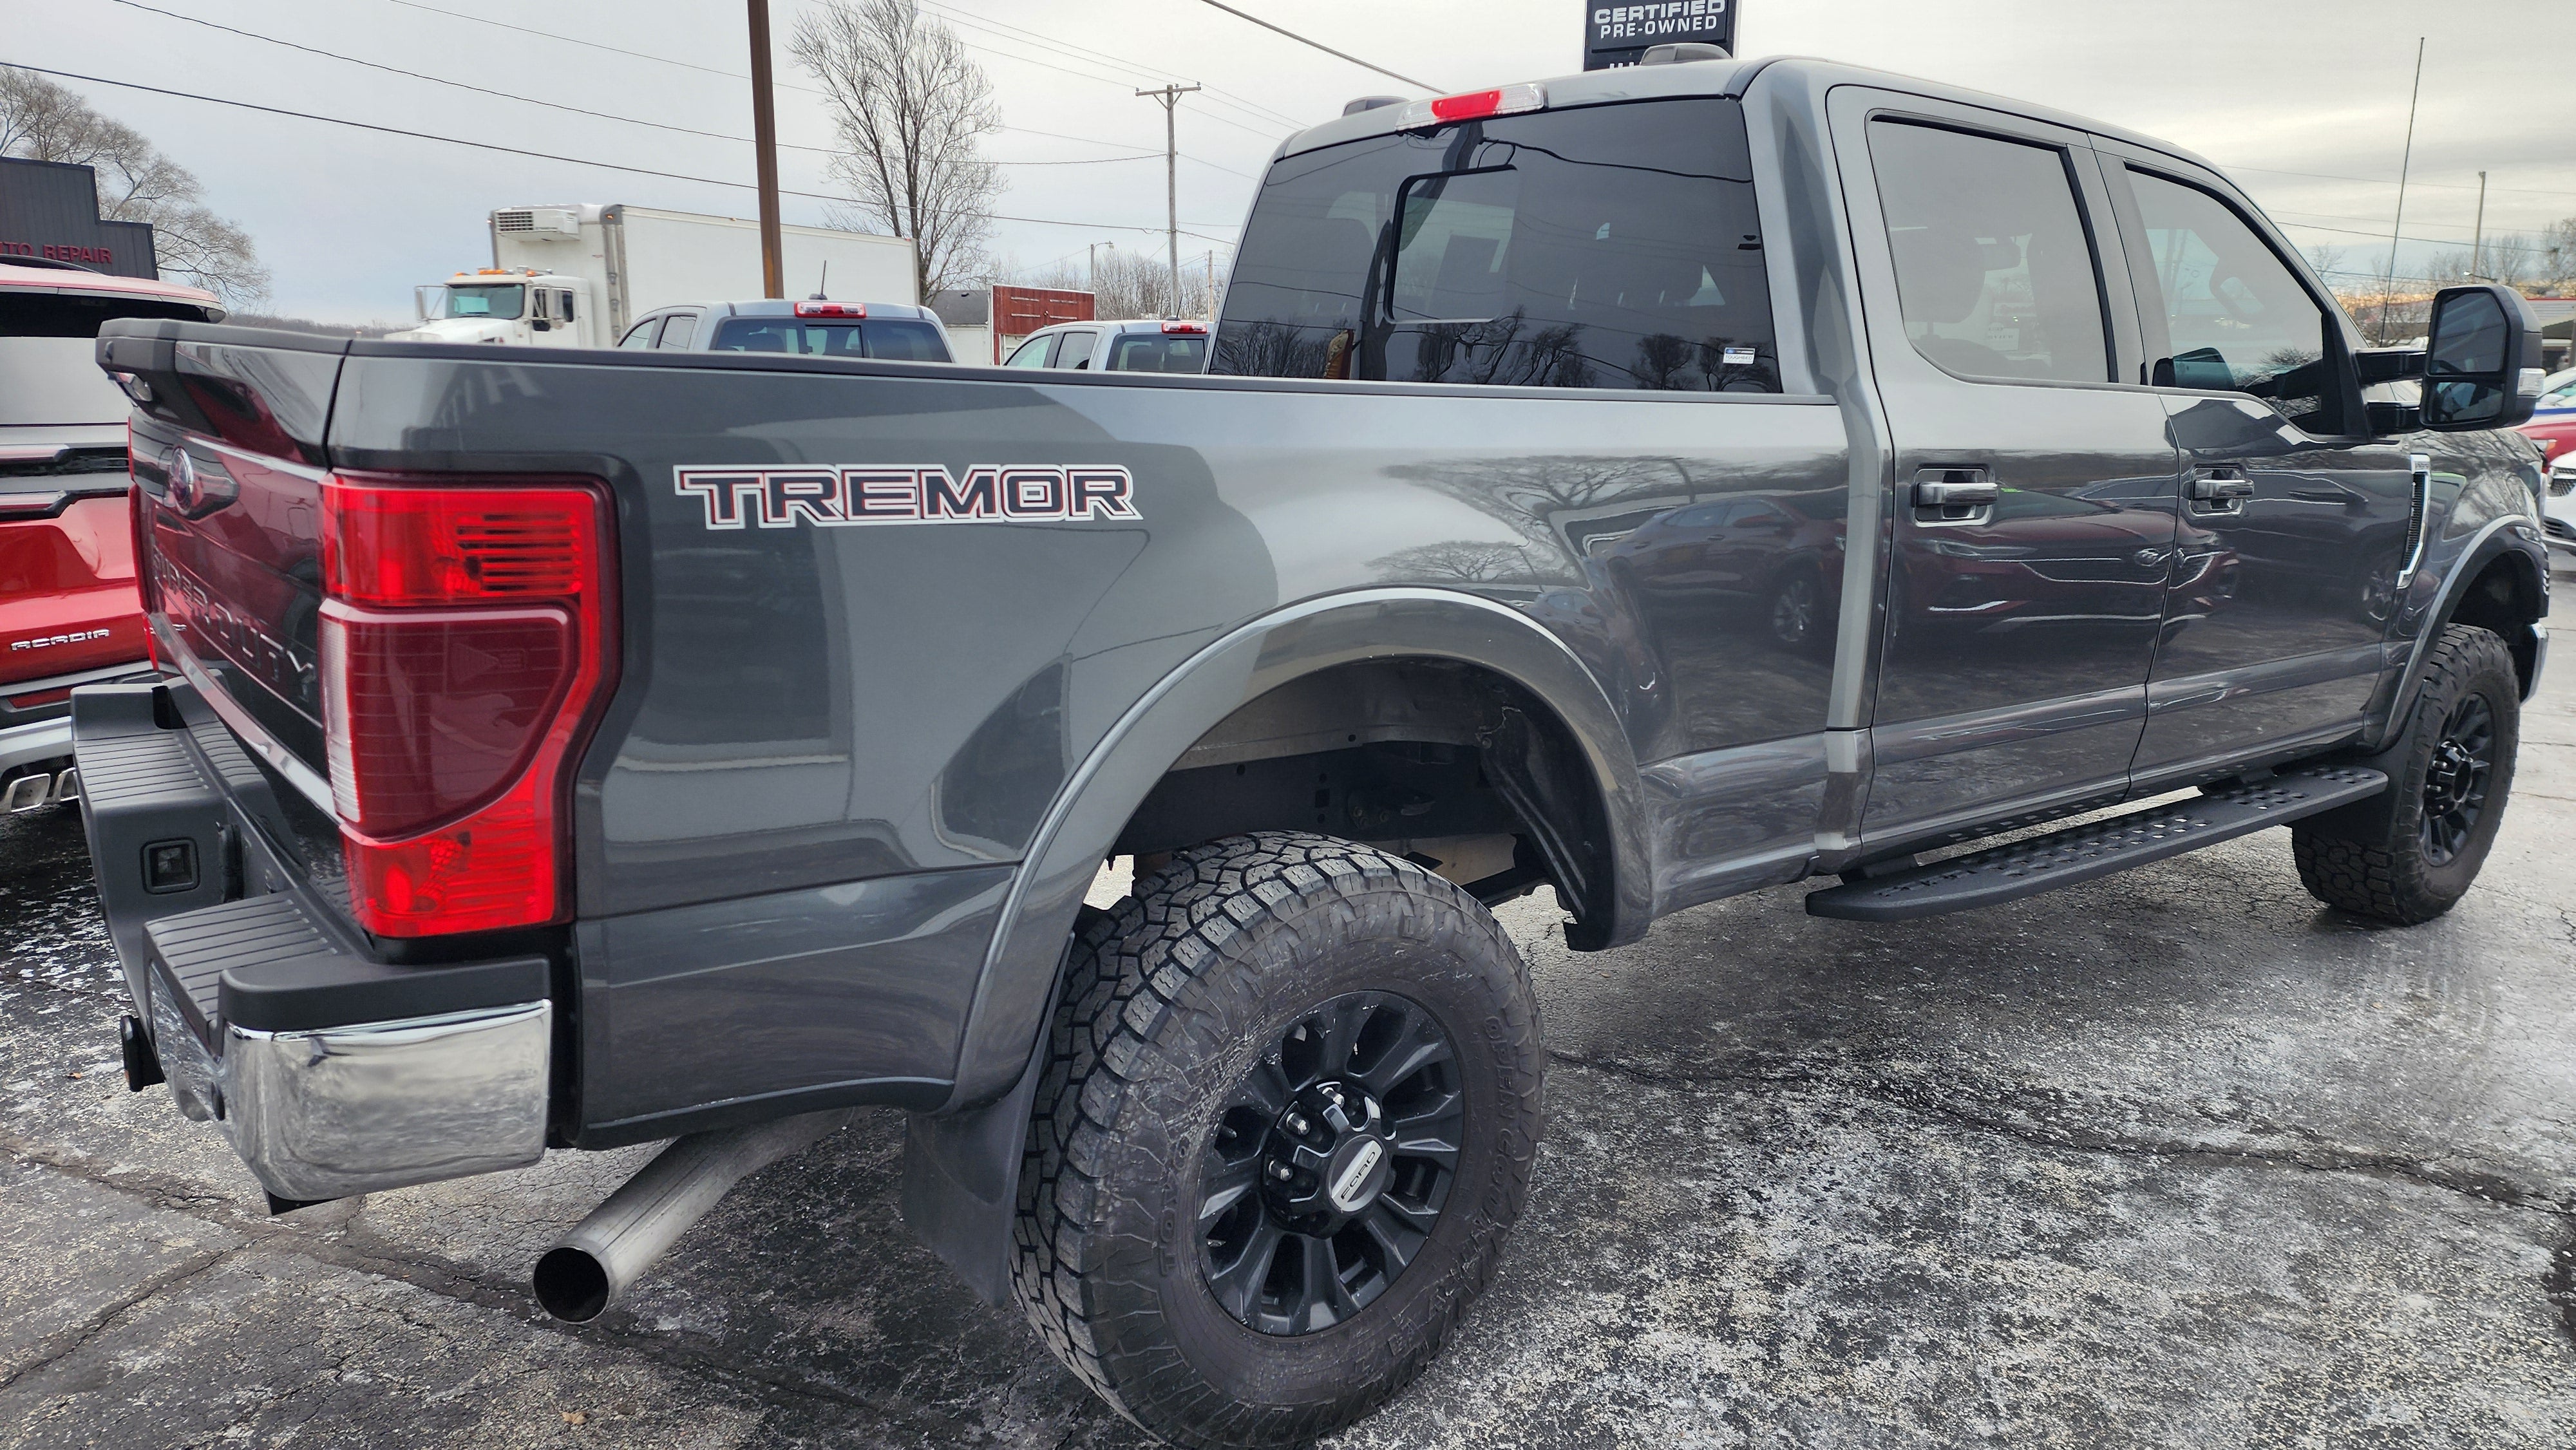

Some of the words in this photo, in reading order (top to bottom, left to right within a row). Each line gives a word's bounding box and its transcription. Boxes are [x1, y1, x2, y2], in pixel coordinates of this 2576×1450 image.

[1594, 0, 1725, 24] CERTIFIED
[1600, 15, 1717, 39] PRE-OWNED
[0, 241, 33, 257] TO
[43, 244, 112, 264] REPAIR
[673, 464, 1144, 529] TREMOR
[11, 628, 110, 651] ACADIA
[213, 602, 316, 703] DUTY
[1484, 1015, 1515, 1120] OPEN
[1341, 1151, 1376, 1200] FORD
[1160, 1136, 1191, 1277] TOYO
